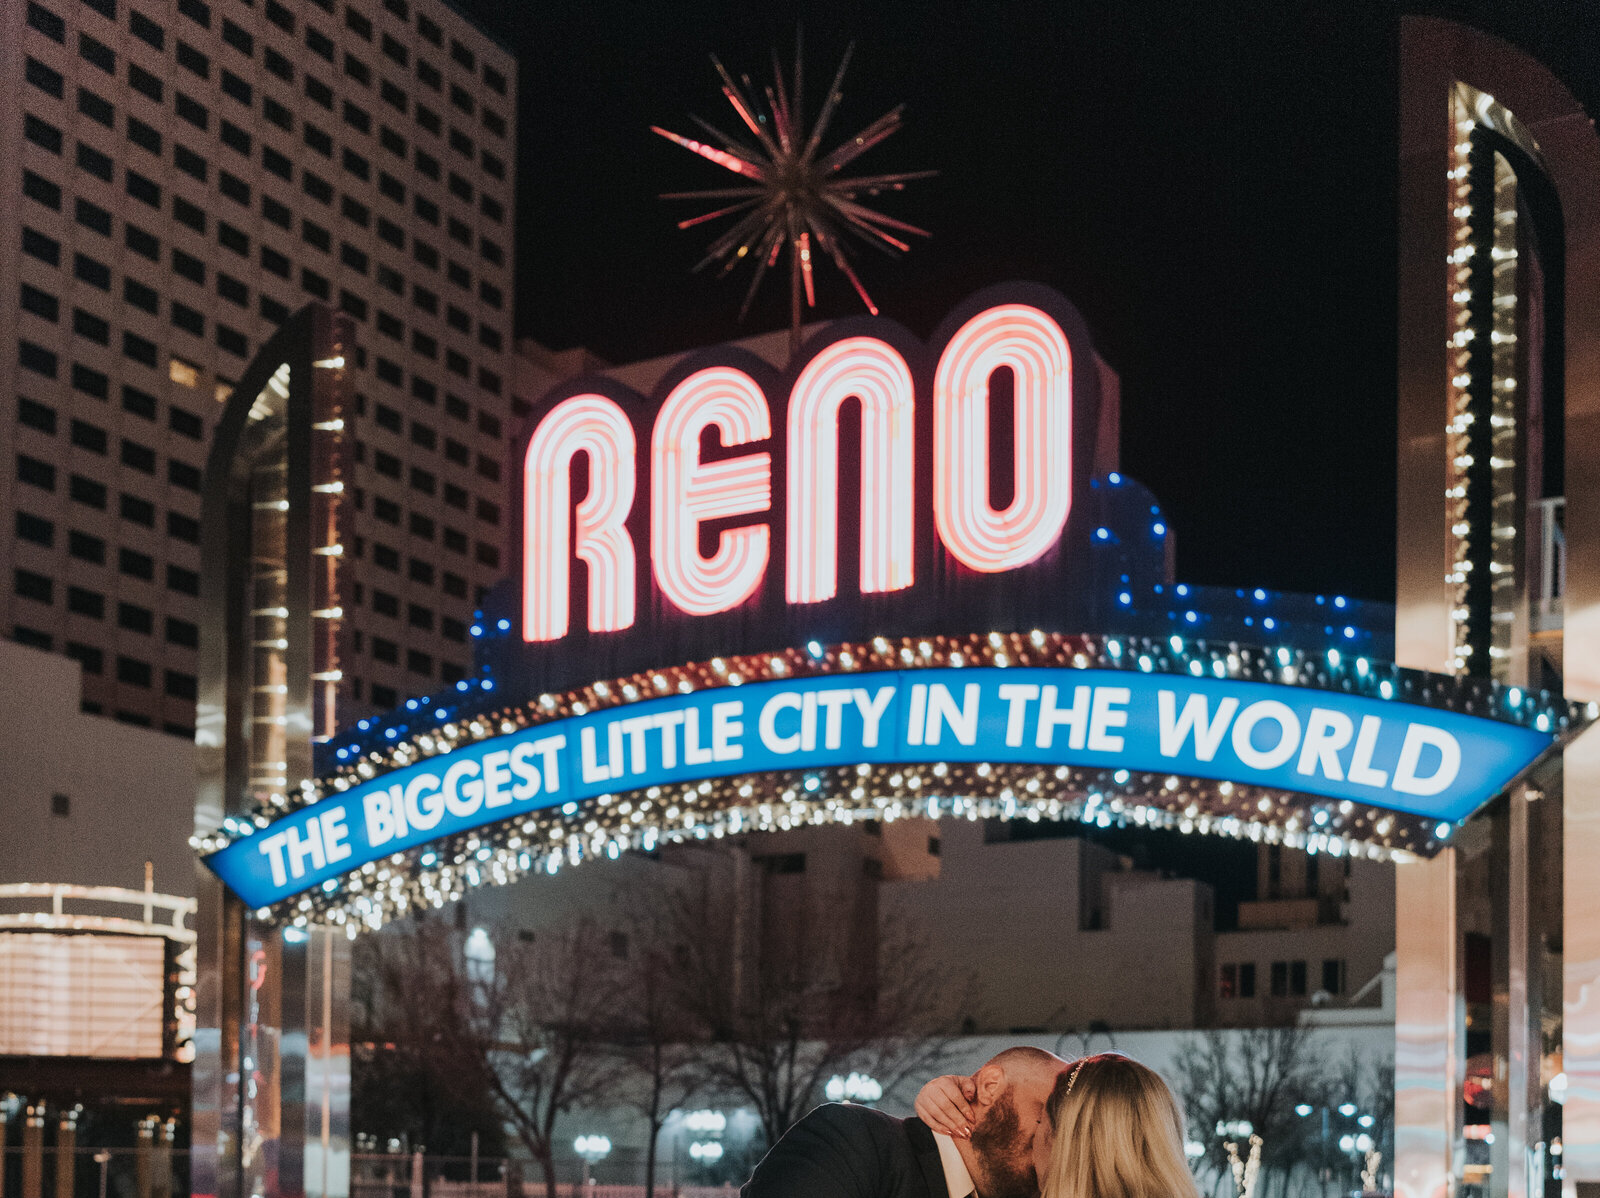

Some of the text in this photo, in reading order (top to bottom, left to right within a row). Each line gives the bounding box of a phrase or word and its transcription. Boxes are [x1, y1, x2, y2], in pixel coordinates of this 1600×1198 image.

[259, 684, 1462, 886] THE BIGGEST LITTLE CITY IN THE WORLD
